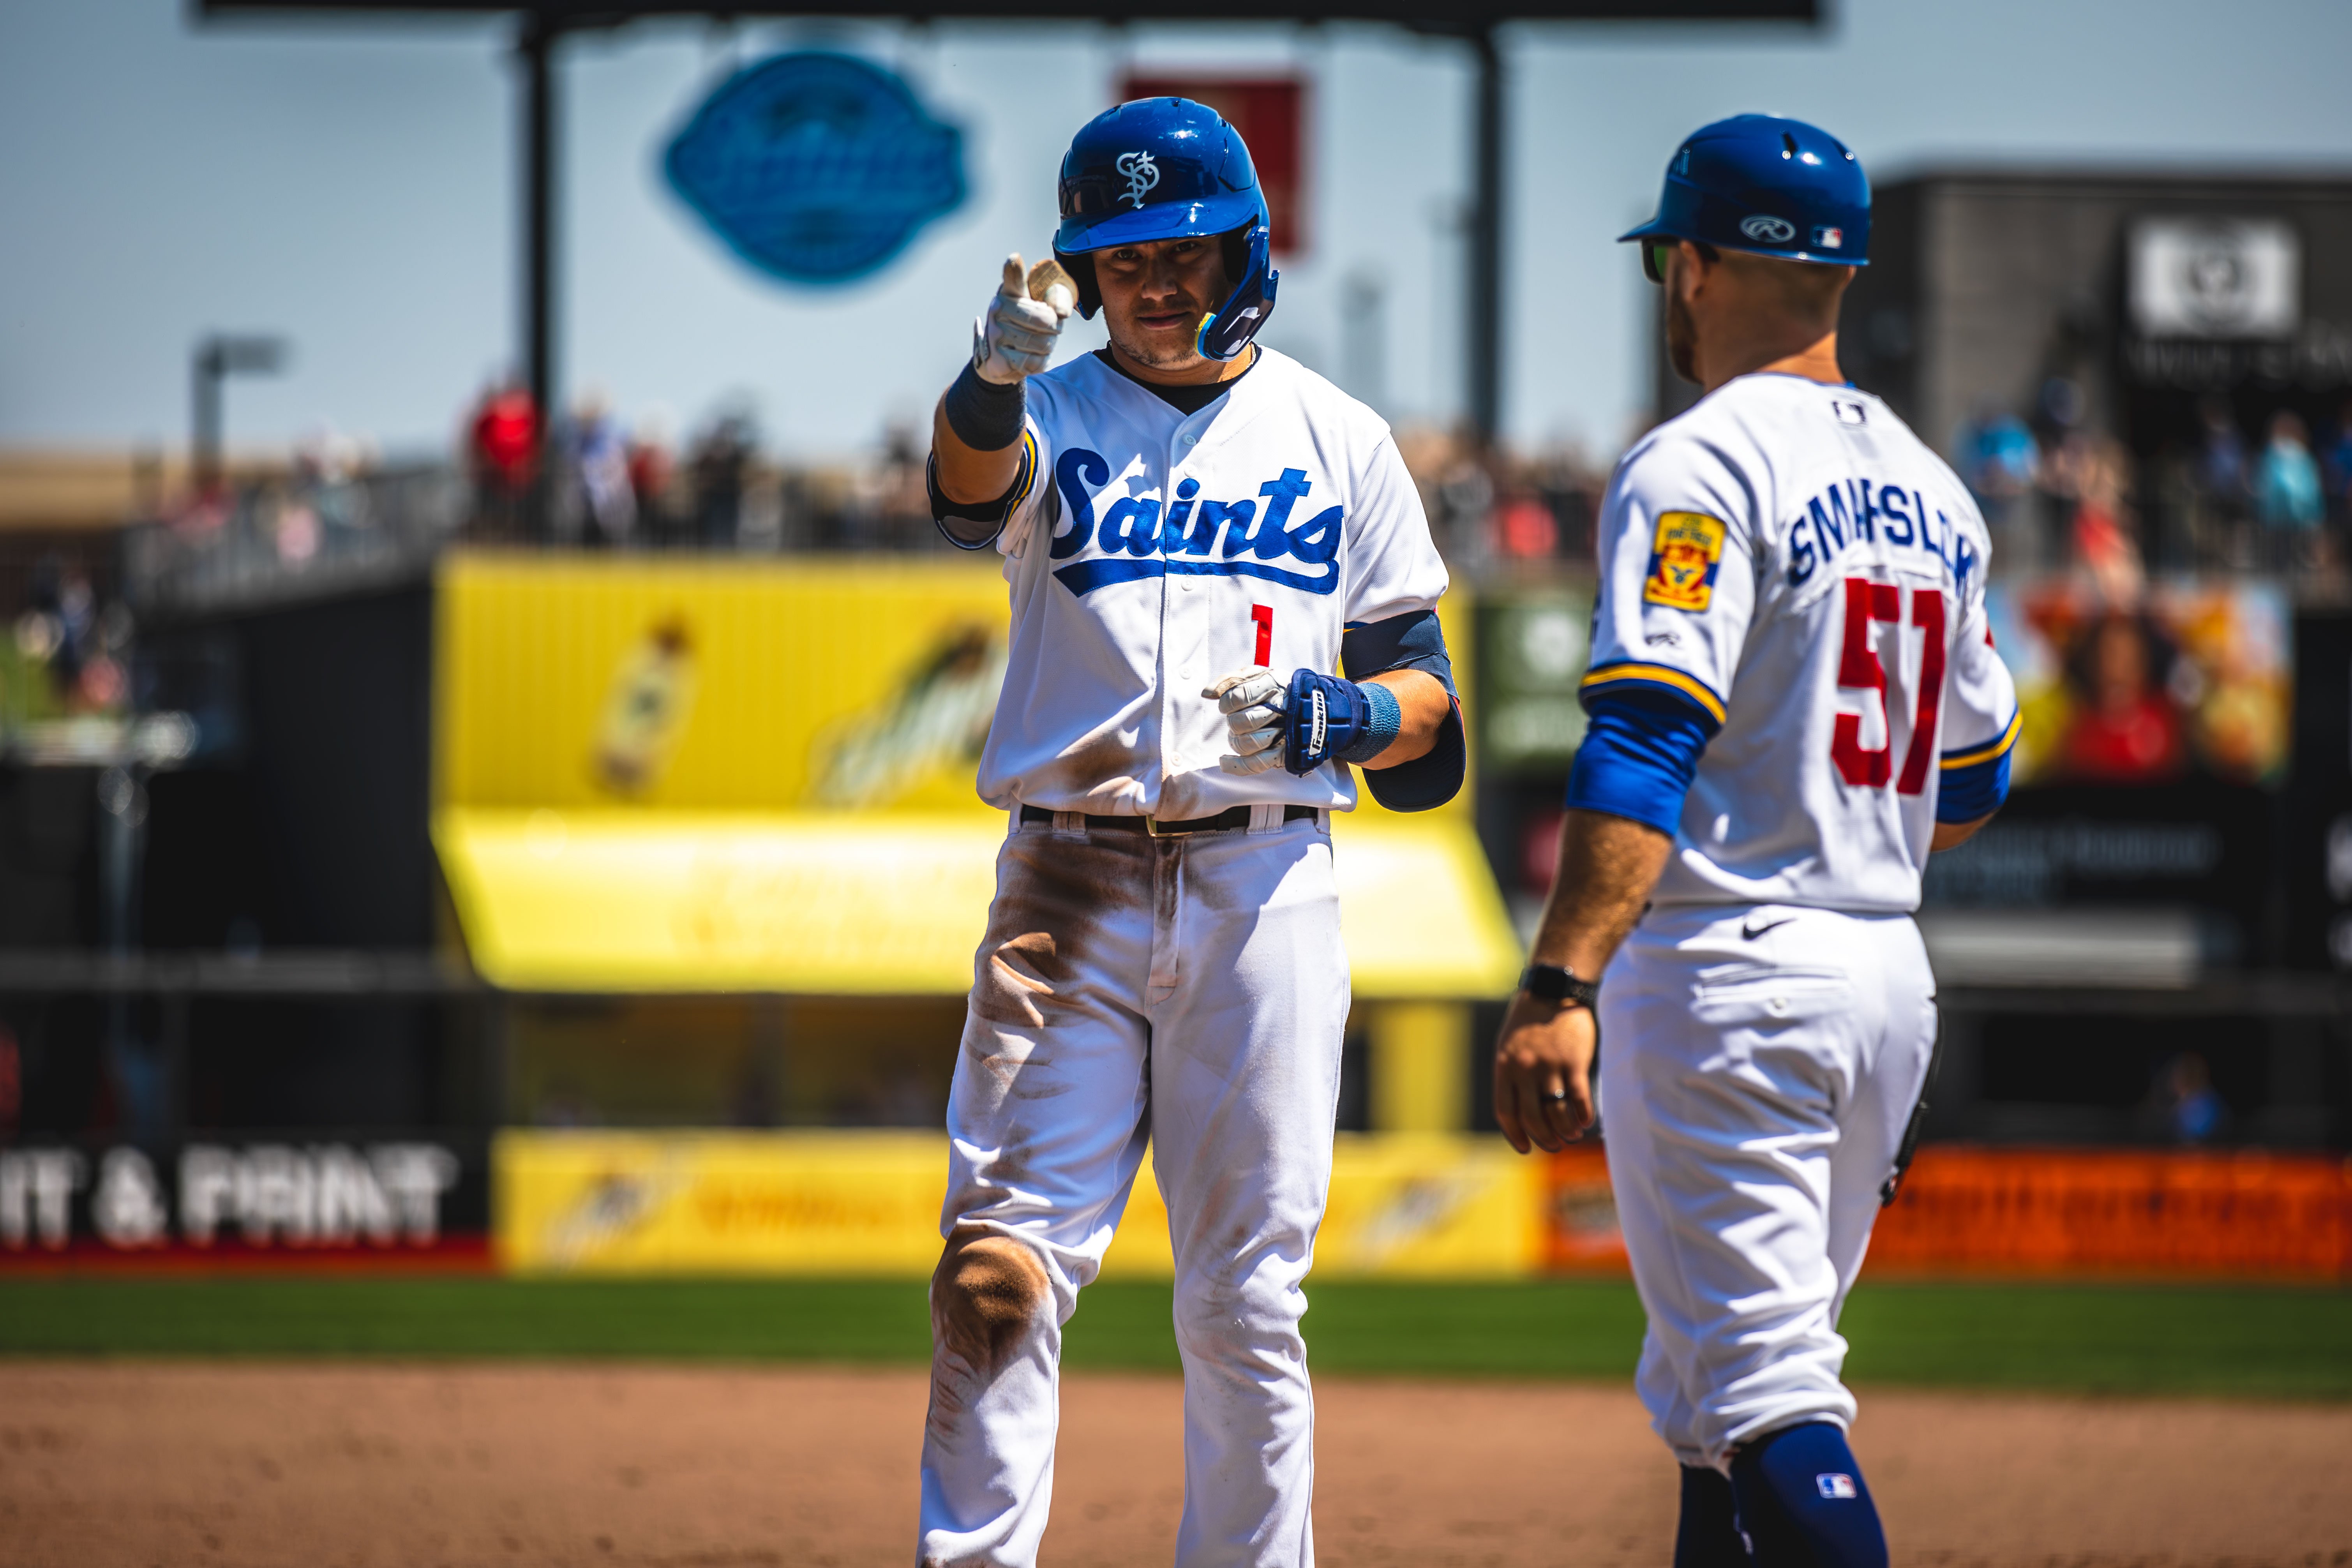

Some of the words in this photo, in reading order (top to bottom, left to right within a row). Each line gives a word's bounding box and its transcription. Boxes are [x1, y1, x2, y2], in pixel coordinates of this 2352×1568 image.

[1050, 447, 1344, 564] Saints
[1251, 603, 1273, 667] 1
[1831, 577, 1946, 795] 57
